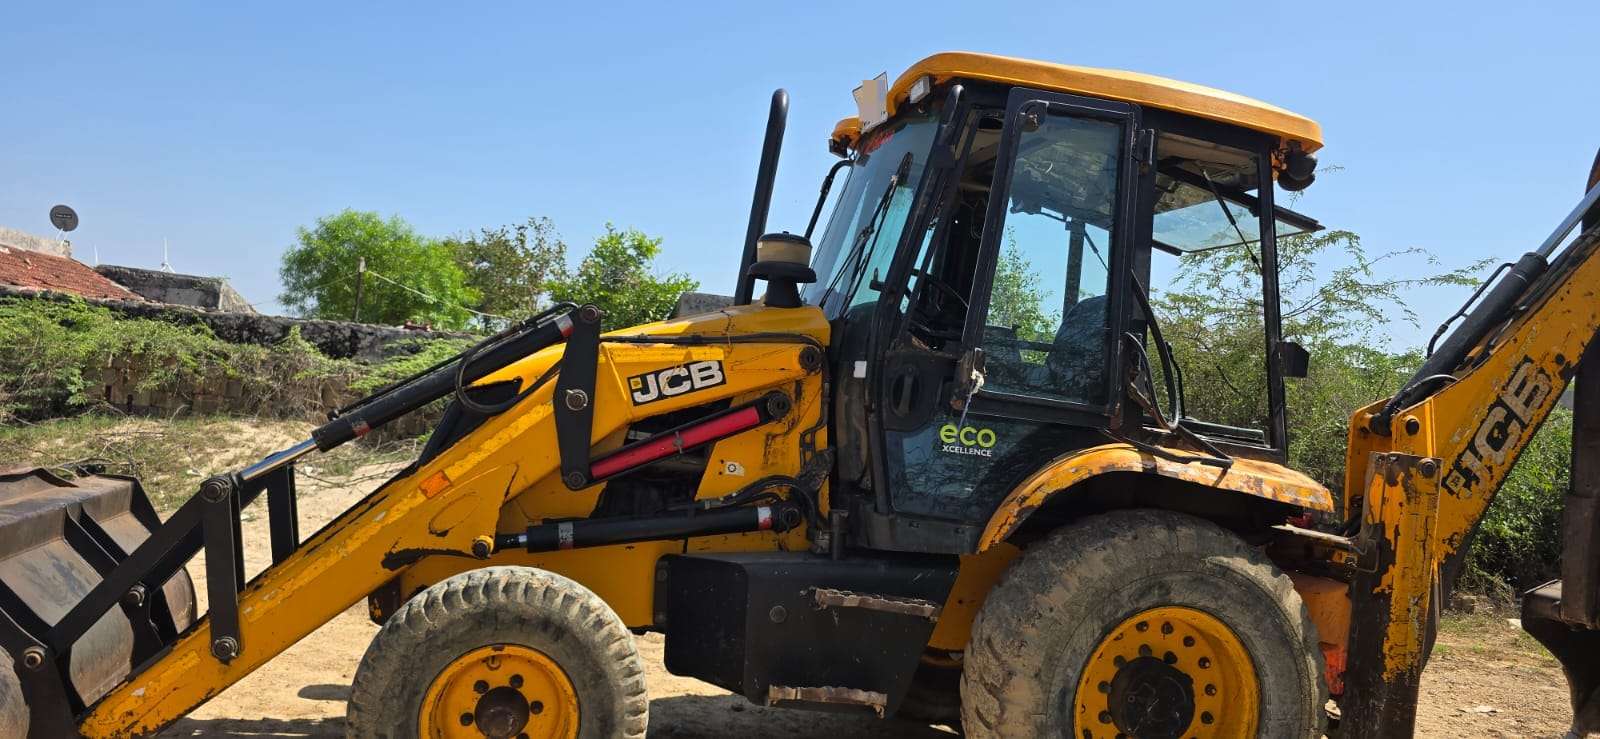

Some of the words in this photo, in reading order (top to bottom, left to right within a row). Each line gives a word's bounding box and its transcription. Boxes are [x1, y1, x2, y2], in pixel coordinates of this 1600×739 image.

[632, 360, 724, 403] JCB
[940, 424, 996, 448] eco
[942, 445, 993, 457] XCELLENCE
